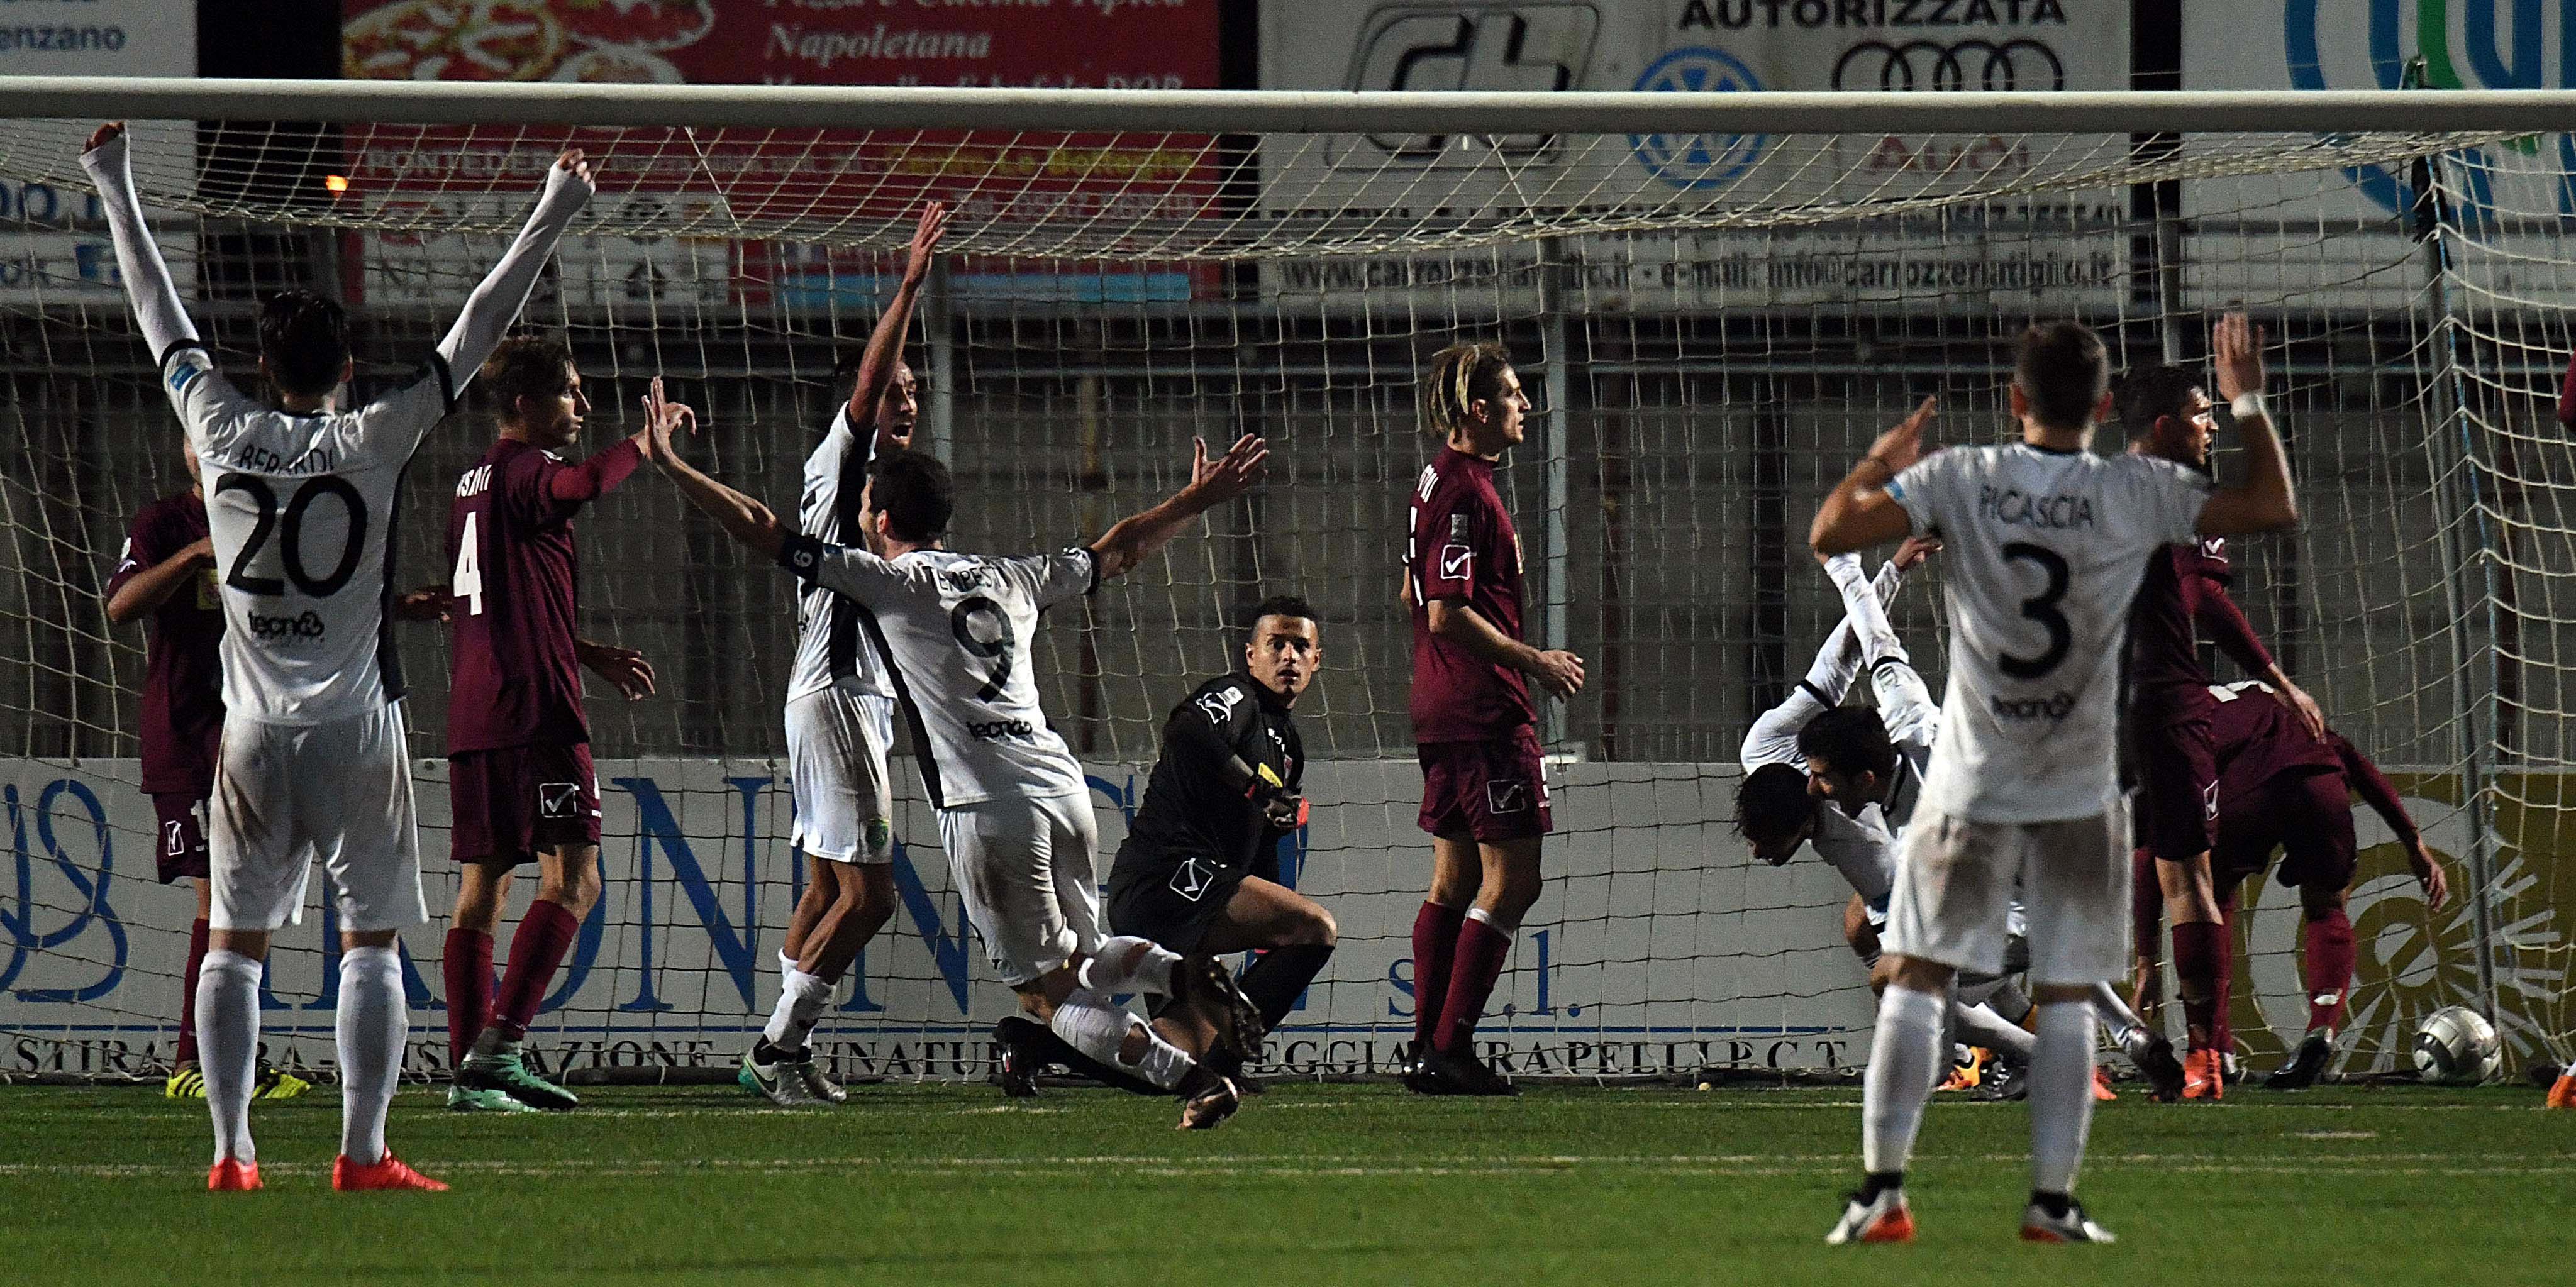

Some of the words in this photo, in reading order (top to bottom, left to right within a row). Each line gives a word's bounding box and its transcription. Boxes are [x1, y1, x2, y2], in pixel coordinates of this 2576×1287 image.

[764, 23, 992, 68] Napoletana
[1679, 0, 2067, 30] AUTORIZZATA
[1869, 135, 2029, 174] Audi
[214, 473, 368, 598] 20
[453, 511, 483, 616] 4
[951, 597, 1016, 703] 9
[1999, 541, 2071, 680] 3
